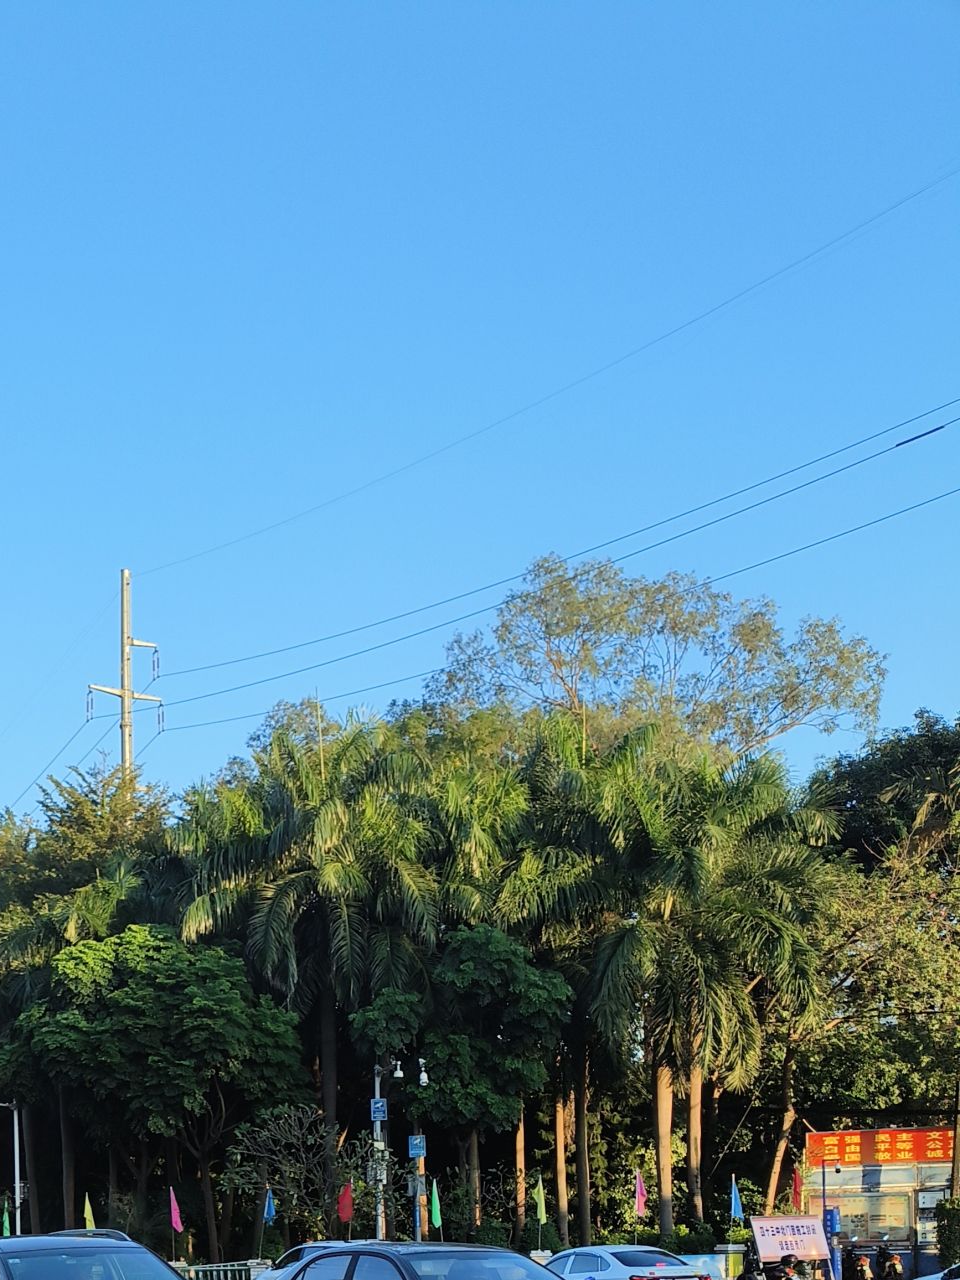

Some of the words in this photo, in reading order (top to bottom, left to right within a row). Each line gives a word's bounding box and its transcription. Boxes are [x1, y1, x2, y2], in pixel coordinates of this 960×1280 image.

[822, 1135, 861, 1145] 富强
[874, 1133, 914, 1142] 民主
[874, 1142, 914, 1151] 平等
[874, 1151, 914, 1160] 敬业
